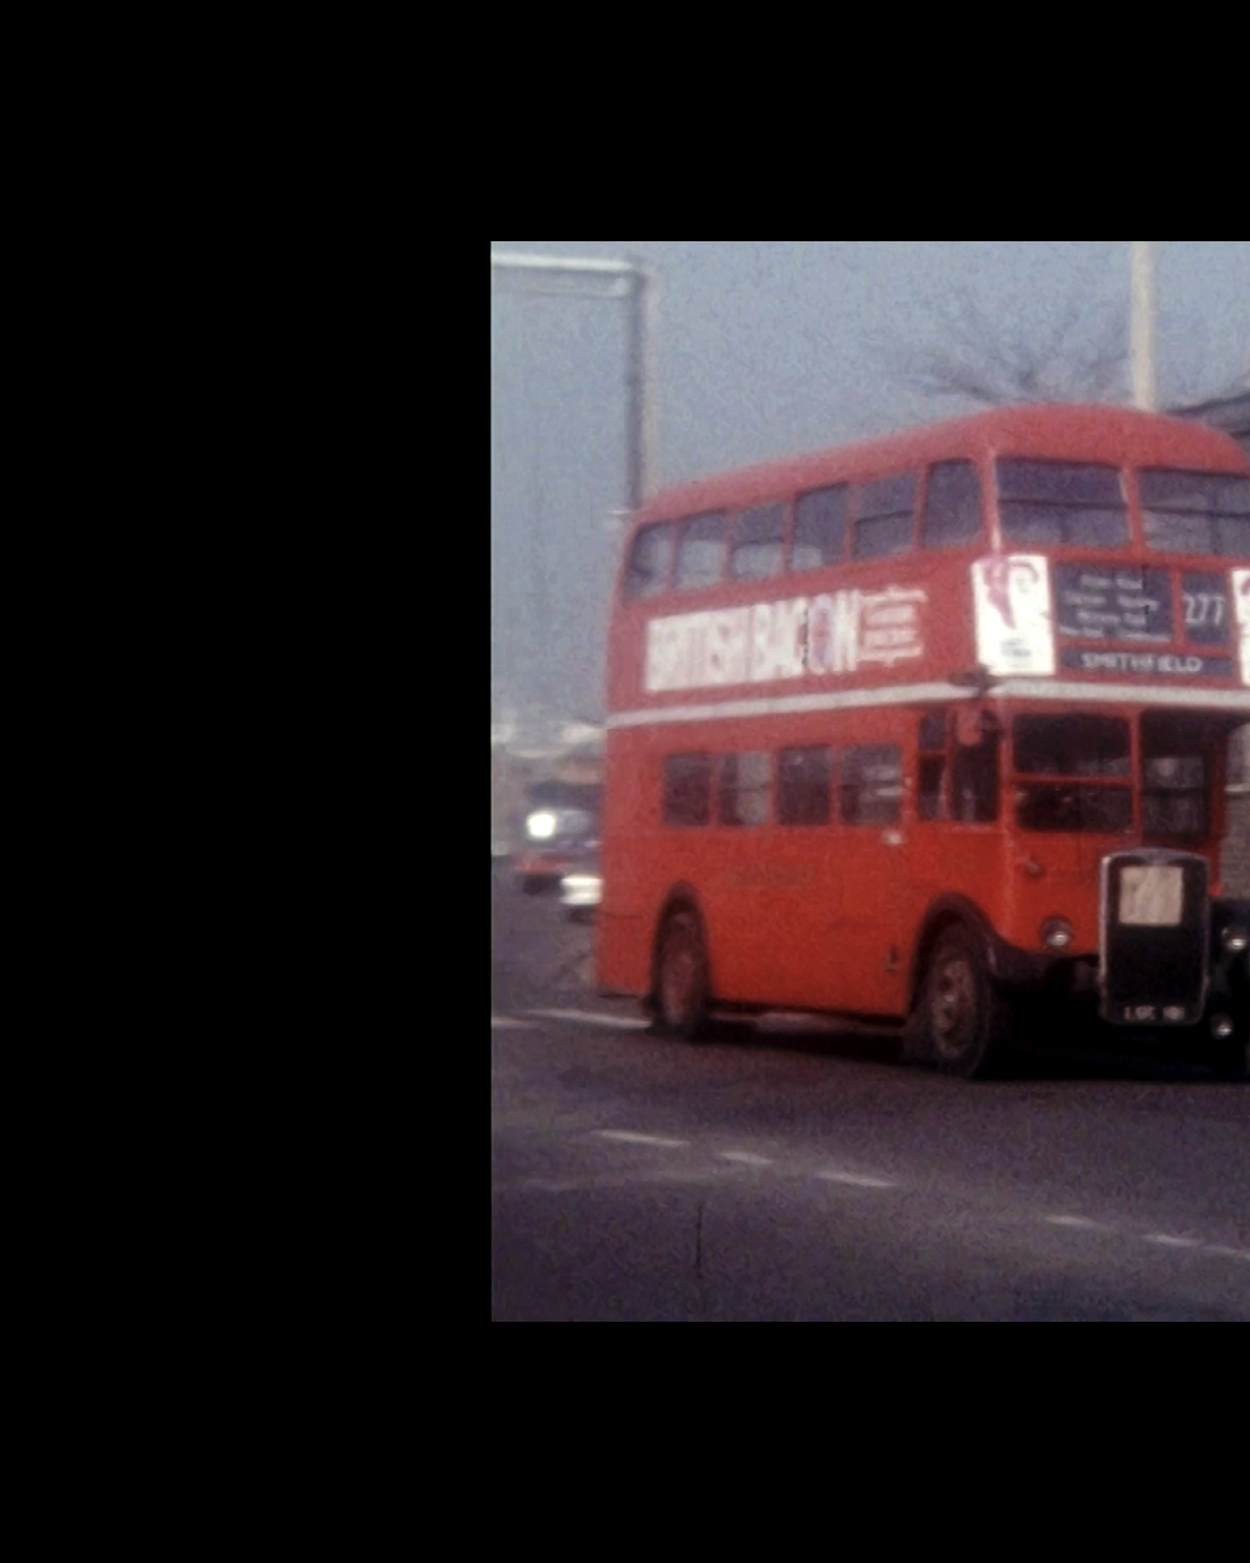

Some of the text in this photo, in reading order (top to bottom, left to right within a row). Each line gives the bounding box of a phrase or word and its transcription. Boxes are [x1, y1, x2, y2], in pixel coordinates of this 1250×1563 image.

[1181, 592, 1227, 627] 277
[751, 589, 860, 683] BACON
[1081, 652, 1204, 674] SMITHFIELD
